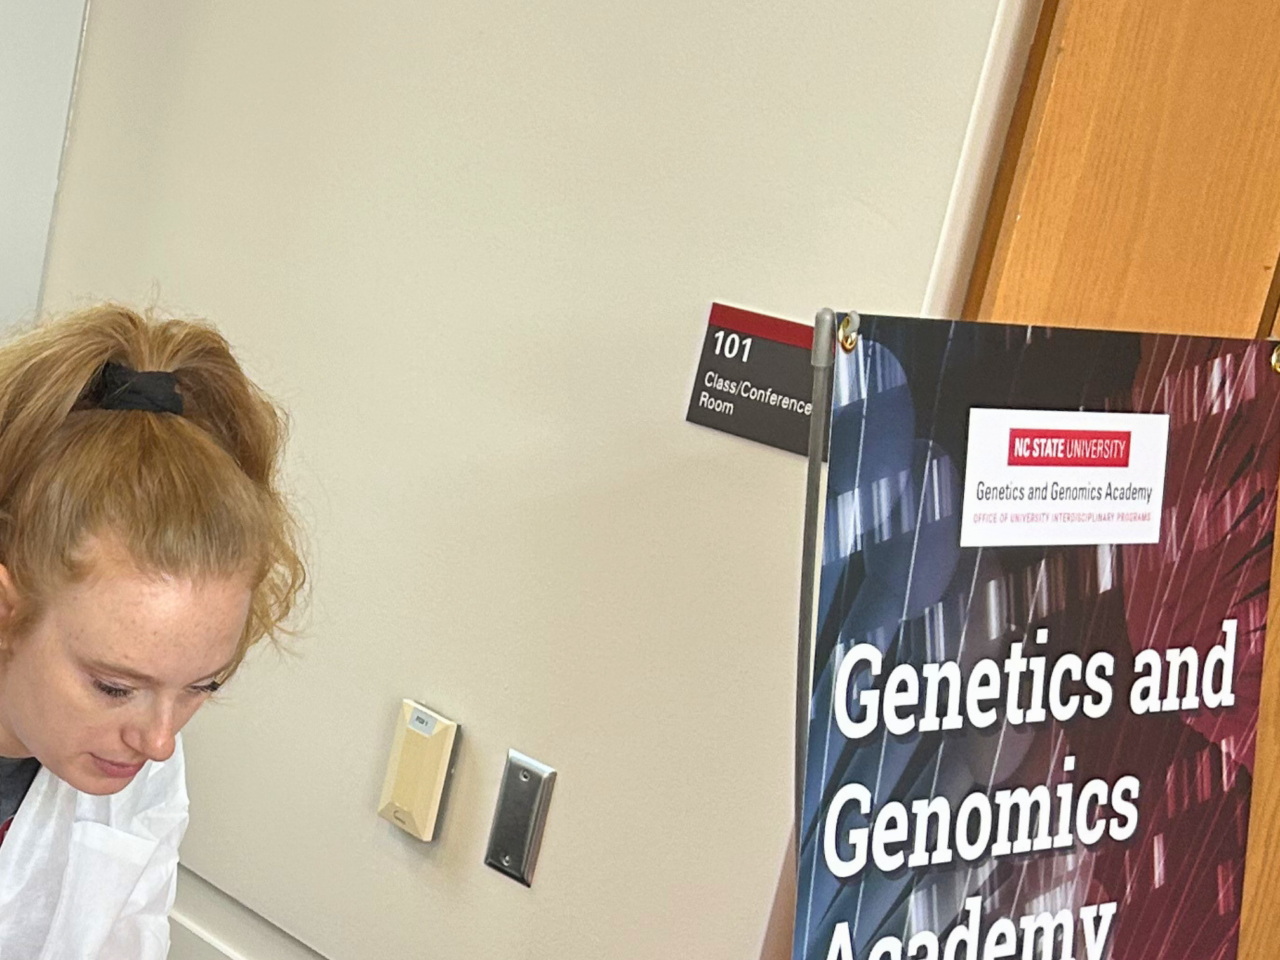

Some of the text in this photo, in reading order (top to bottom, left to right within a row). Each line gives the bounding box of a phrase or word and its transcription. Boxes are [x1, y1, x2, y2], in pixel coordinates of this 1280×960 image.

[714, 330, 752, 362] 101
[699, 391, 734, 415] Room
[704, 371, 813, 415] Class/Conference
[1014, 438, 1126, 459] NC STATE UNIVERSITY
[976, 481, 1152, 504] Genetics and Genomics Academy
[973, 511, 1151, 523] OFFICE OF UNIVERSITY INTERDISCIPLINARY PROGRAMS
[834, 619, 1237, 739] Genetics and
[823, 755, 1140, 878] Genomics
